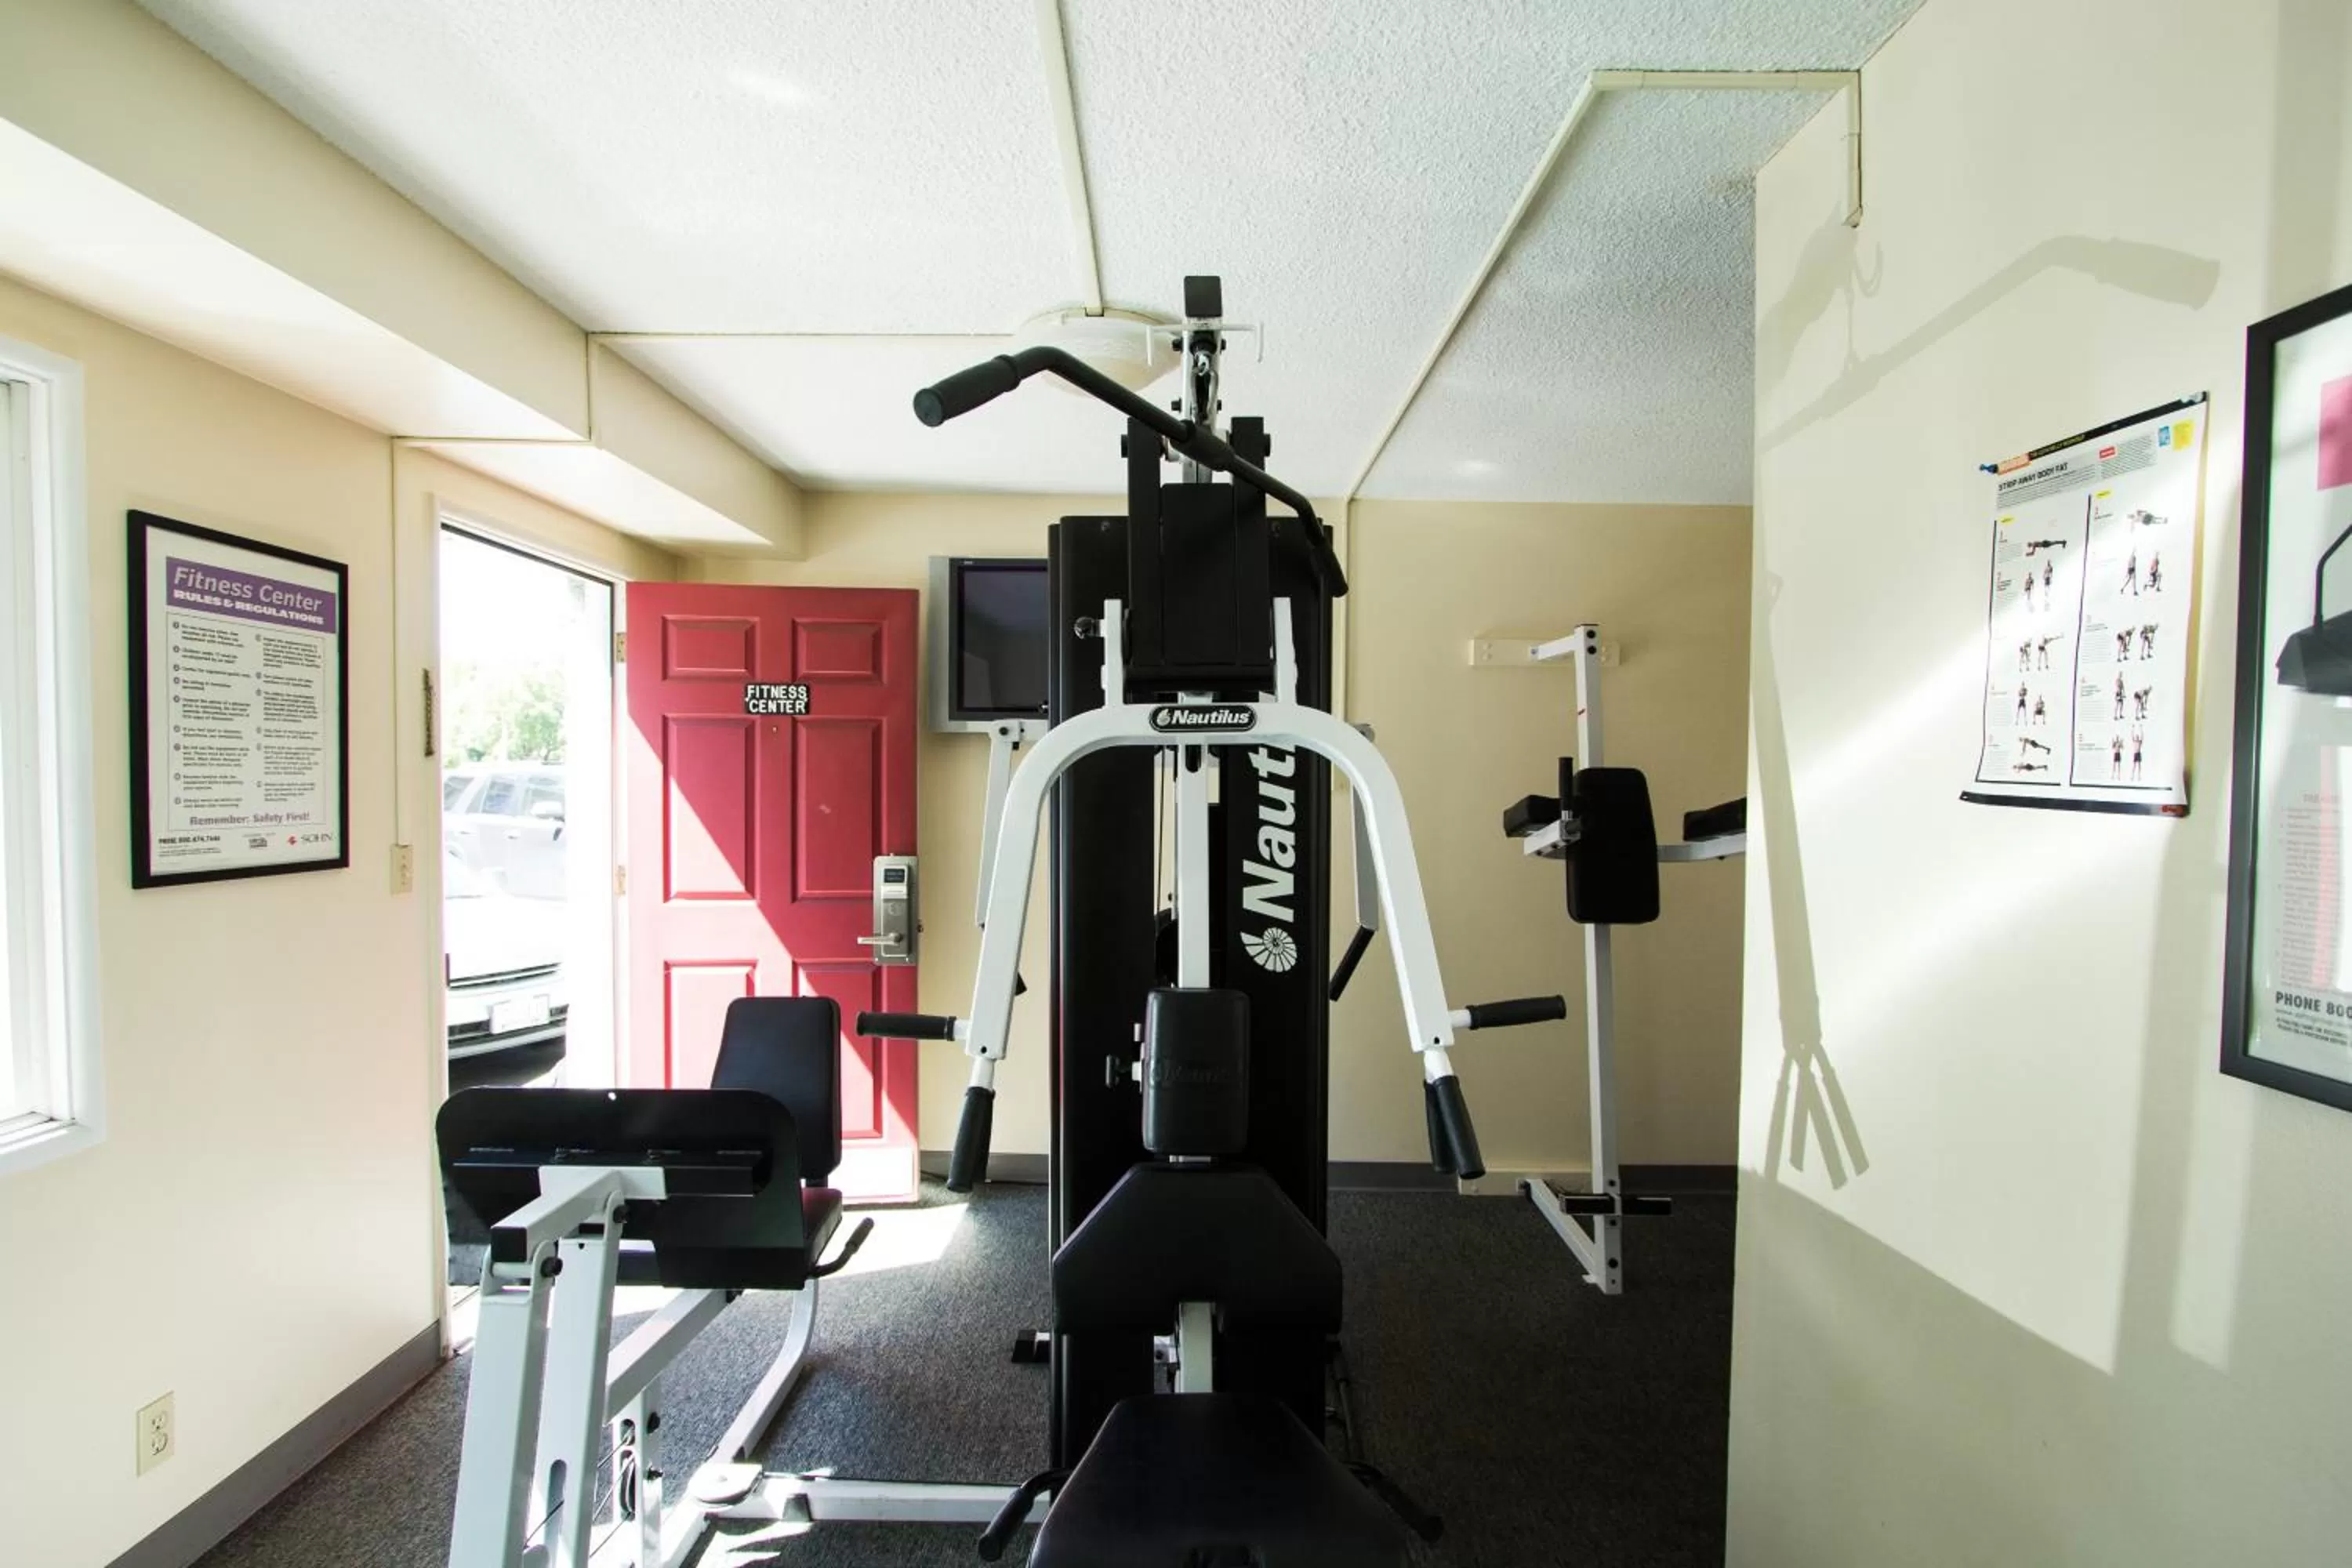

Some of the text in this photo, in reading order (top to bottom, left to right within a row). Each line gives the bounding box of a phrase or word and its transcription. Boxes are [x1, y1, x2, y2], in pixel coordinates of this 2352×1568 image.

[2019, 474, 2036, 485] AWAY
[2038, 467, 2055, 478] BODY
[2056, 462, 2068, 472] FAT
[174, 566, 323, 612] Fitness Center
[173, 589, 325, 625] RULES & REGULATIONS
[746, 684, 808, 699] FITNESS
[749, 699, 806, 713] CENTER
[1171, 709, 1250, 724] Nautilus
[253, 814, 283, 824] Safety
[1242, 742, 1296, 923] Naut
[2275, 990, 2321, 1012] PHONE
